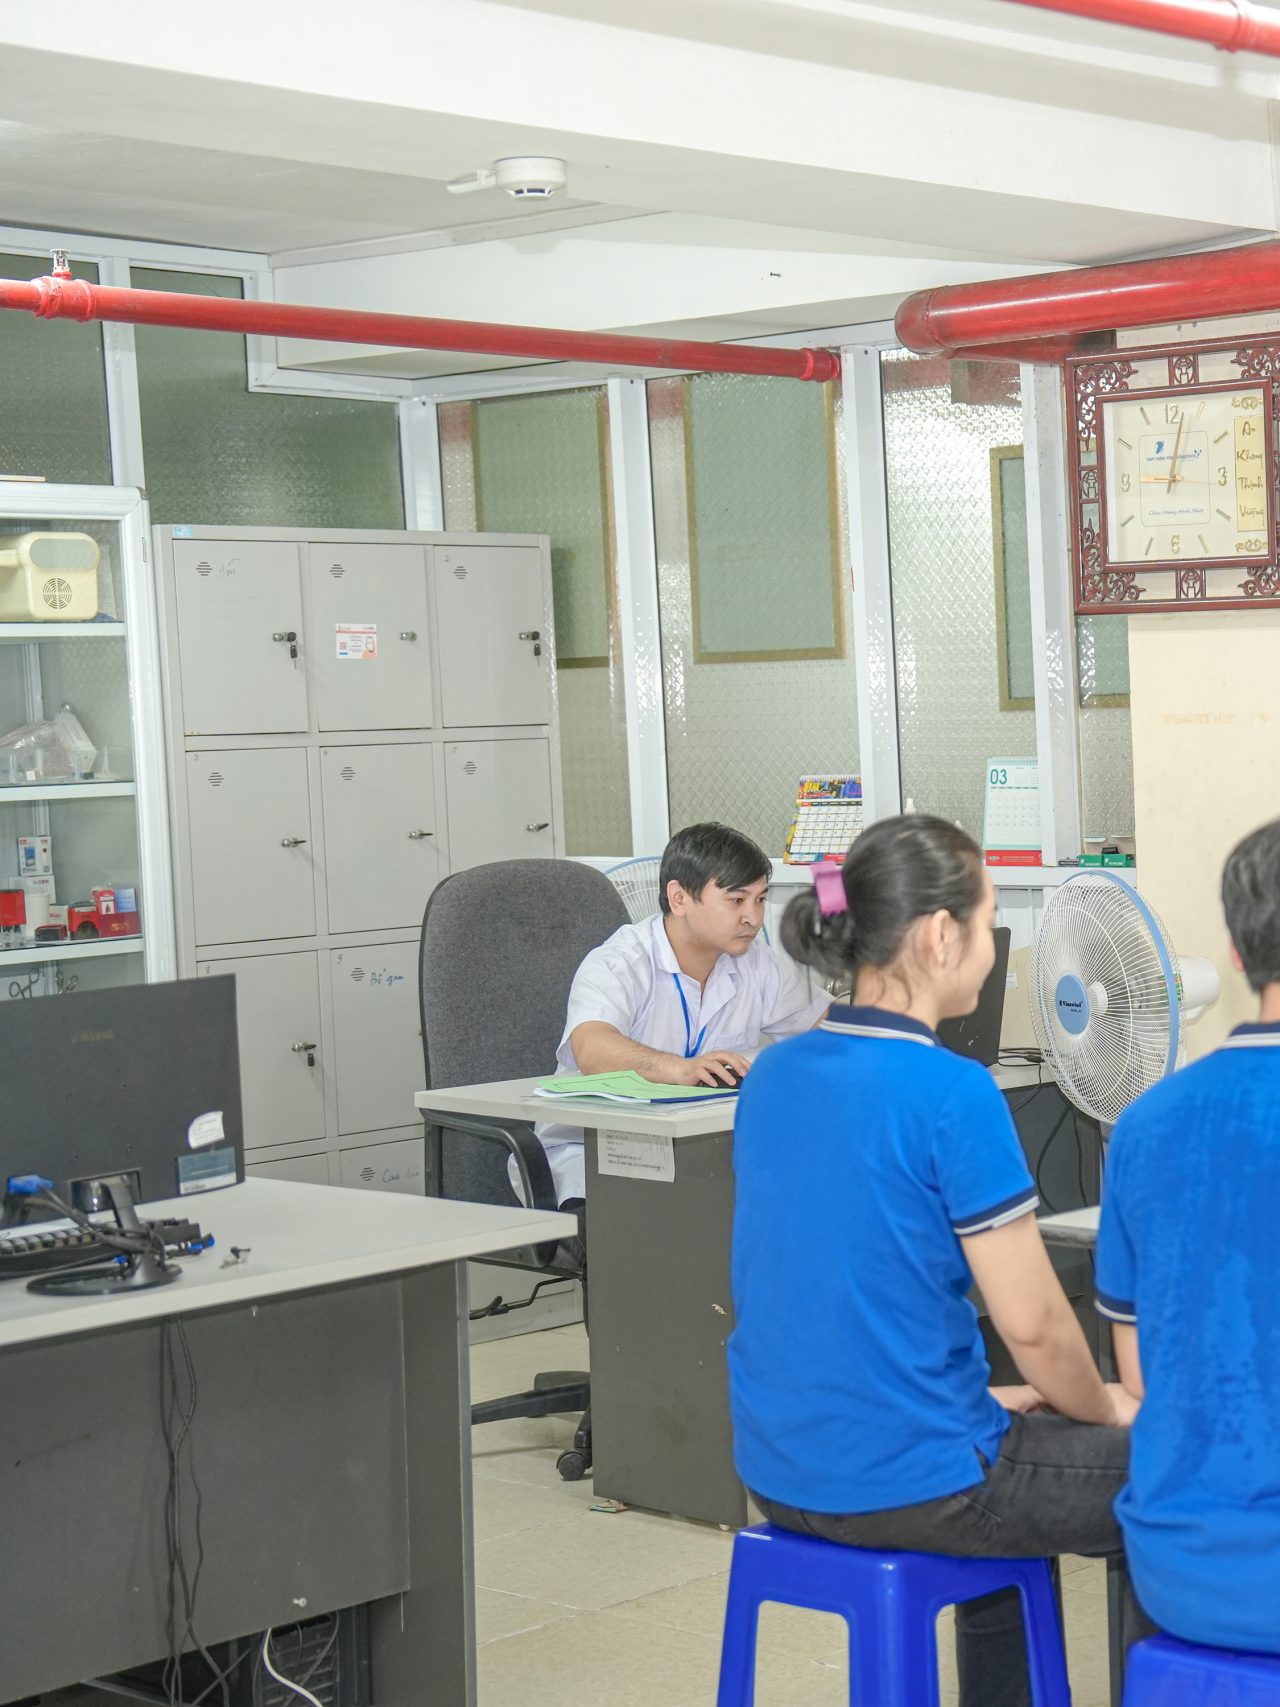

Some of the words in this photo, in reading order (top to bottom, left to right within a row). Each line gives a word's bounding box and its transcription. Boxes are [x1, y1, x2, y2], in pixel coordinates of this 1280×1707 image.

[1164, 403, 1179, 424] 12
[1122, 472, 1131, 492] 9
[1218, 466, 1227, 486] 3
[1171, 535, 1180, 554] 6
[990, 769, 1008, 784] 03
